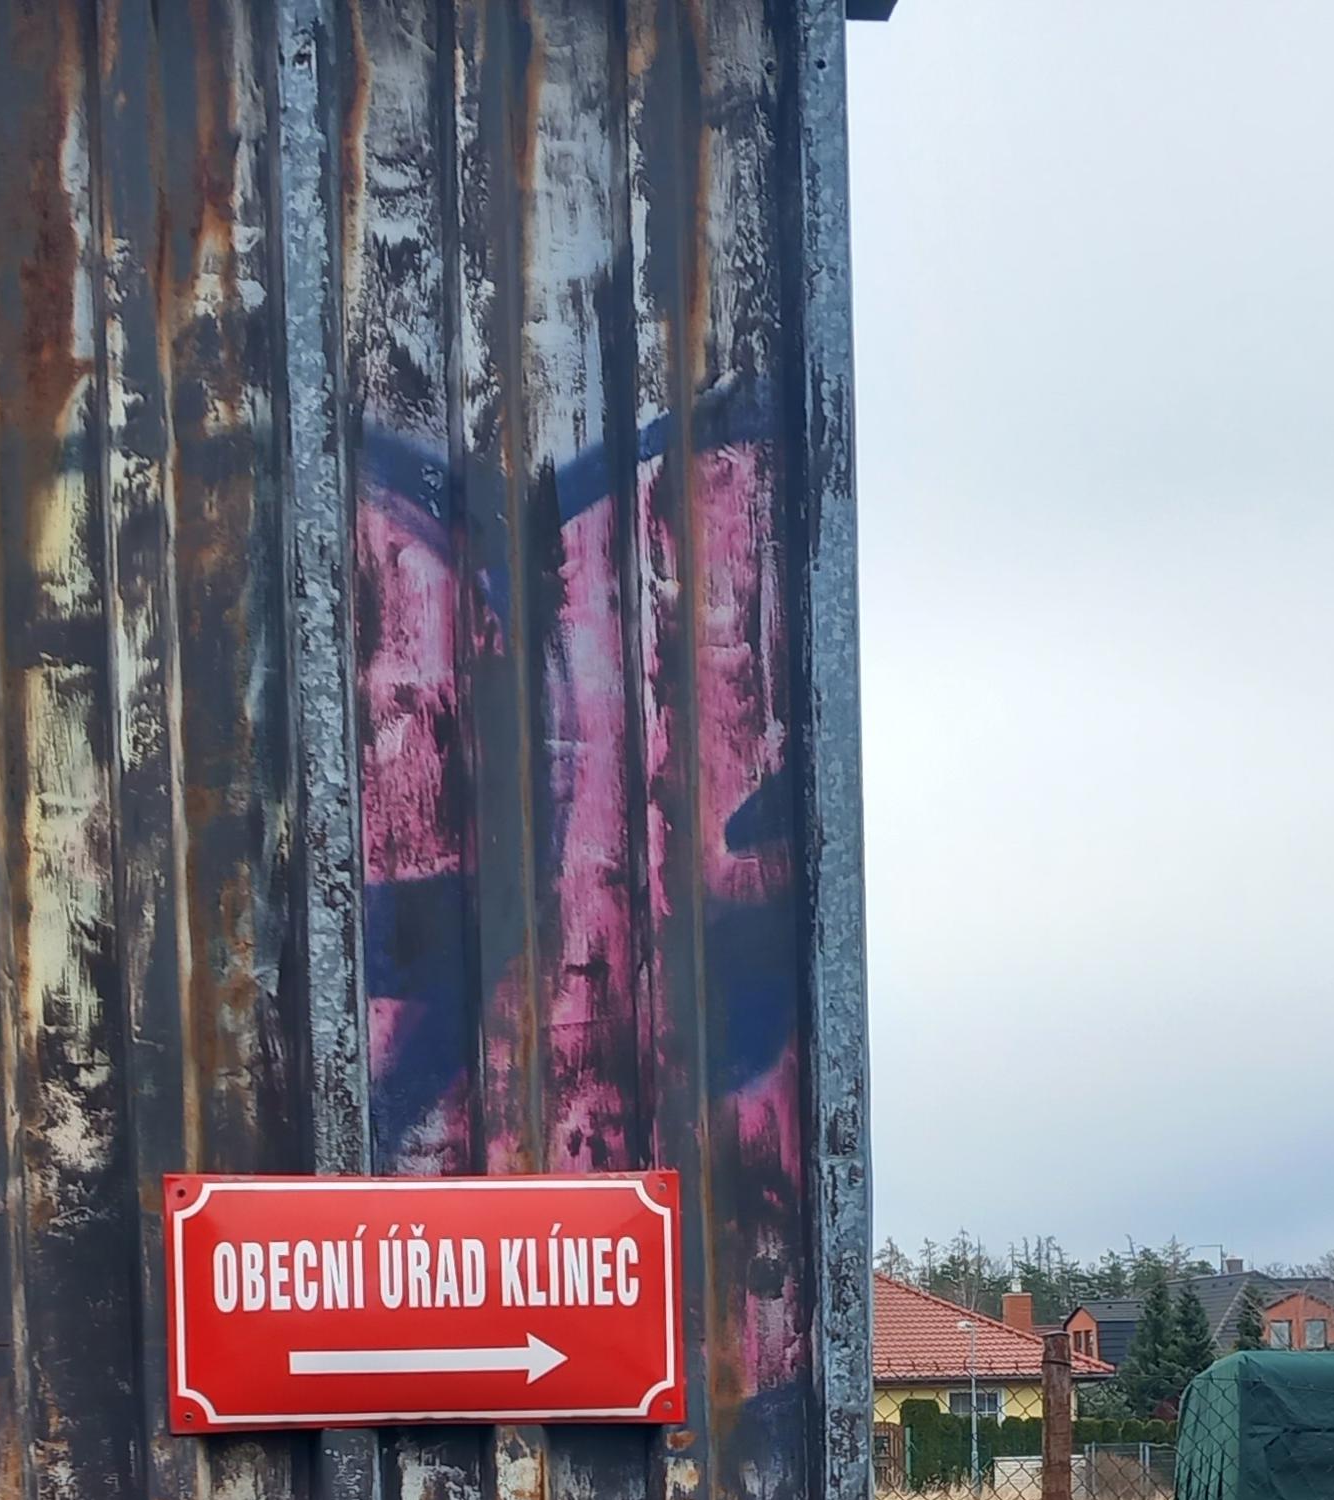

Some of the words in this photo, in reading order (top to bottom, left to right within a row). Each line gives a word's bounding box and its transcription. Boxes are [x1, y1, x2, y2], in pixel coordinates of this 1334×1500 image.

[212, 1224, 366, 1312] OBECNÍ
[378, 1223, 487, 1309] ÚŘAD
[500, 1223, 639, 1307] KLÍNEC
